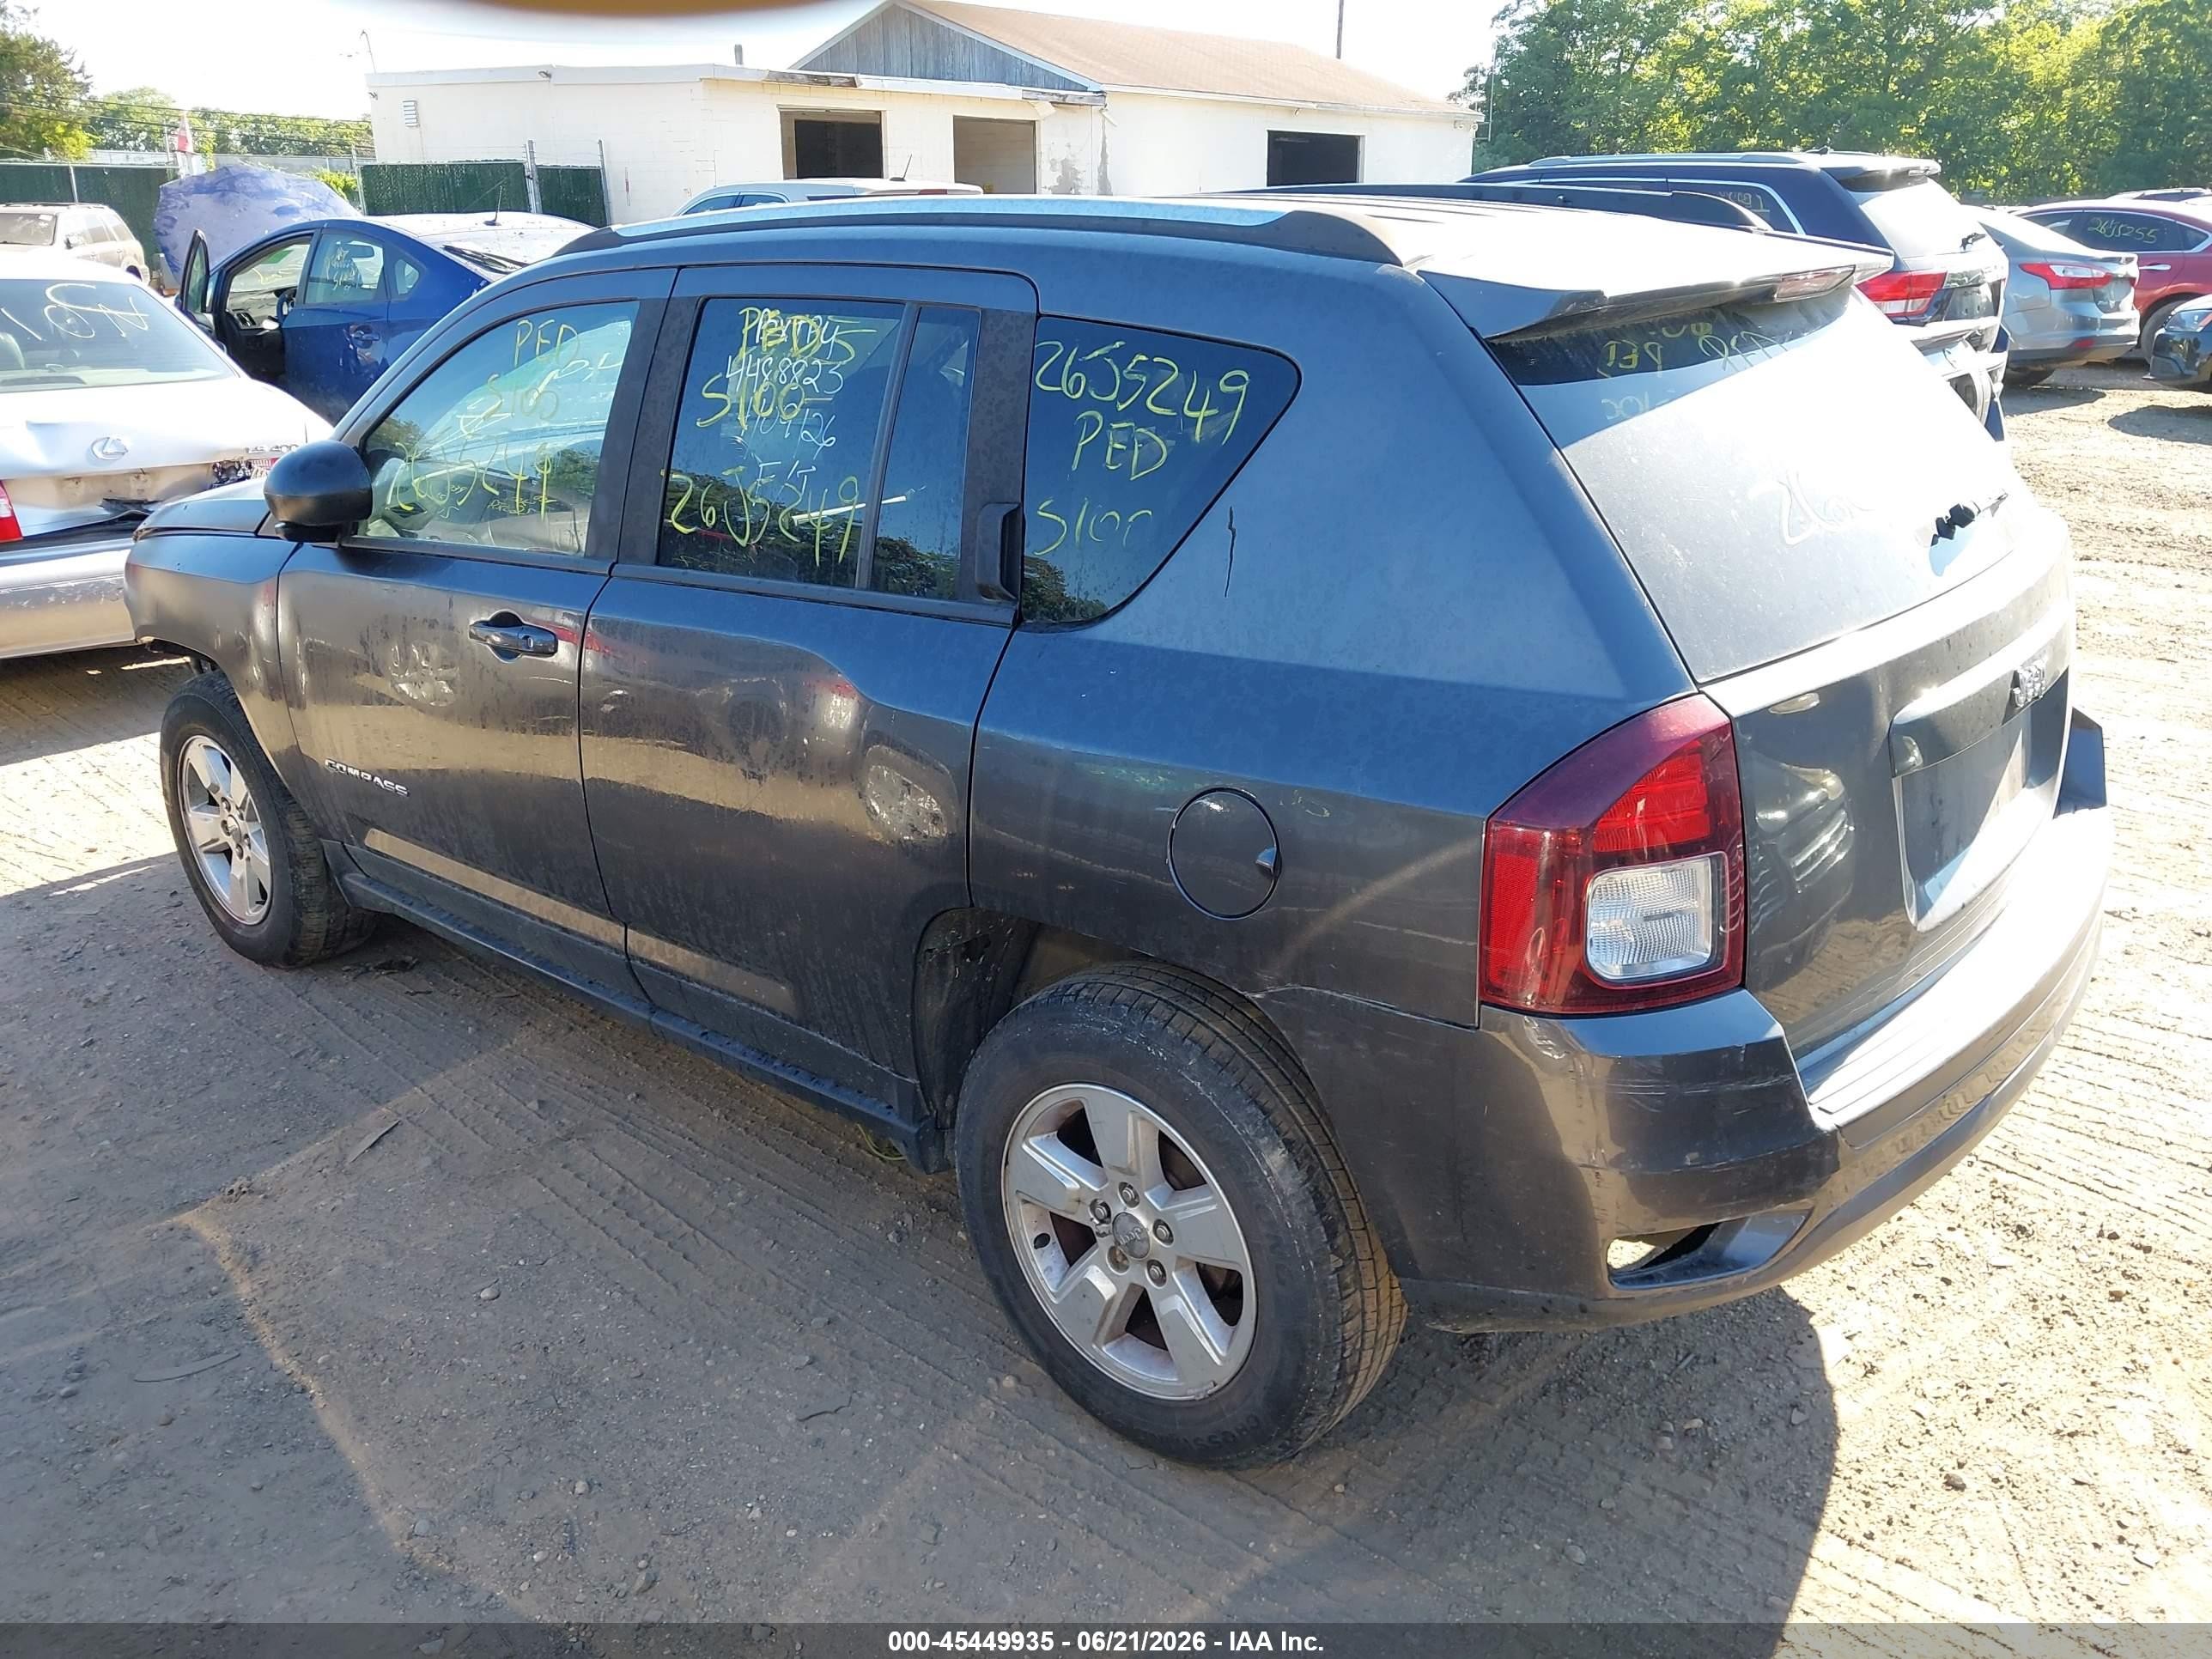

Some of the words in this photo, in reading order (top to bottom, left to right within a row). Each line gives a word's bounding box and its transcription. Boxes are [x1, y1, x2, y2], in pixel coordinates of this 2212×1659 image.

[514, 319, 579, 368] PED
[1071, 410, 1169, 482] PED
[325, 757, 410, 798] COMPASS
